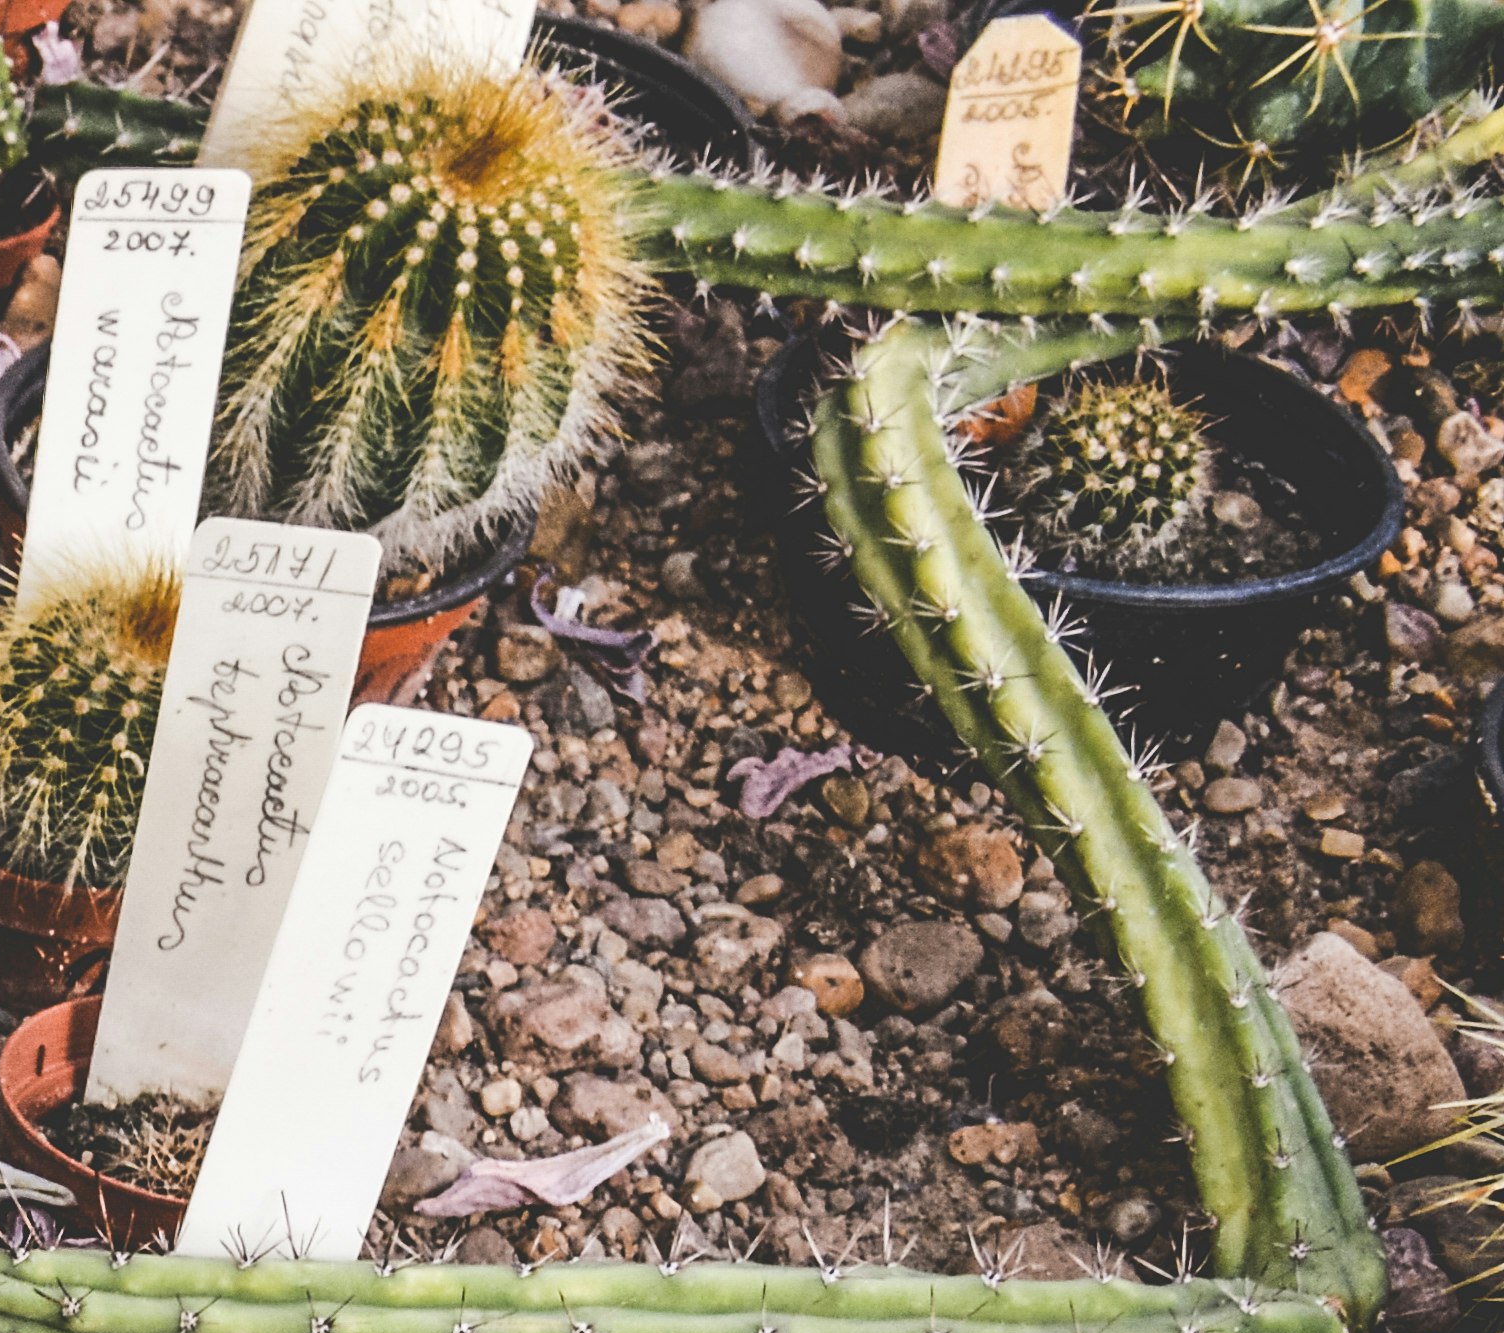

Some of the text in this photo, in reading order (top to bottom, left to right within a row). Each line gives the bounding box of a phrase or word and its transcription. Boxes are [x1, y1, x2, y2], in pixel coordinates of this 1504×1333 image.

[81, 178, 217, 217] 25499
[101, 227, 196, 258] 2007.
[71, 308, 120, 492] warasii
[123, 290, 201, 530] Notocactus
[201, 533, 338, 592] 25171
[220, 590, 320, 624] 2007.
[155, 657, 261, 952] tephracanthus
[243, 644, 331, 888] Notocactus
[353, 719, 498, 770] 24295
[374, 773, 468, 811] 2005.
[316, 837, 407, 1047] sellowii
[356, 834, 469, 1085] Notocactus
